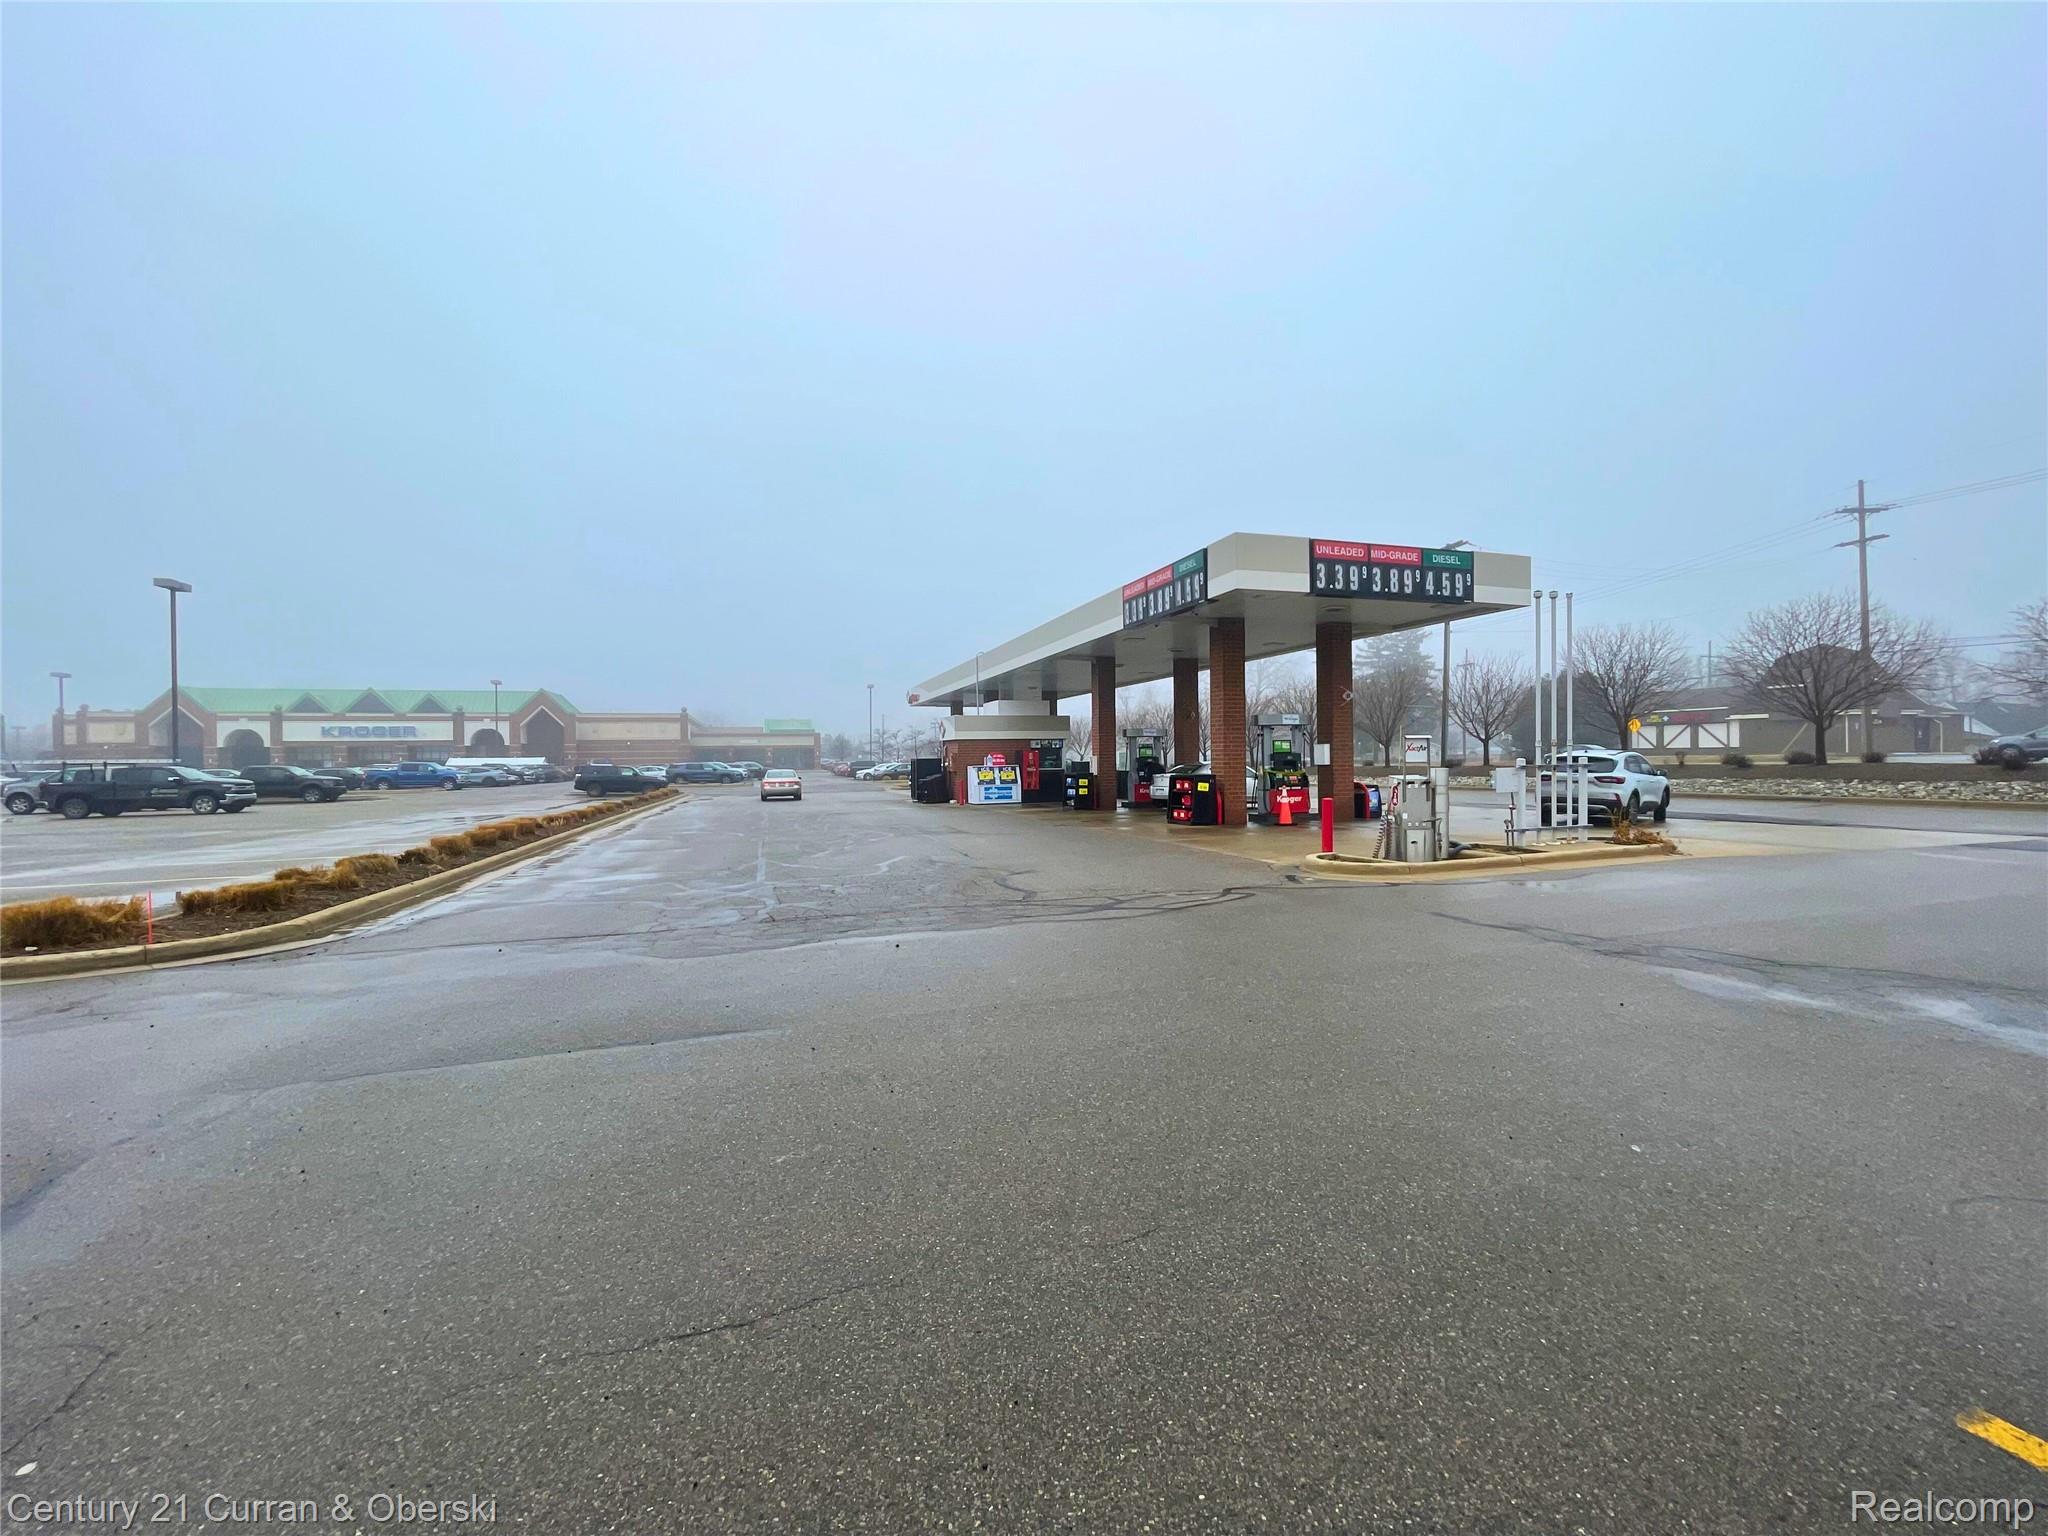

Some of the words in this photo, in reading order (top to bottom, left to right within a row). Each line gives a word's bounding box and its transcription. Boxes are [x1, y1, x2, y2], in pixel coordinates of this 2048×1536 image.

[1316, 545, 1364, 557] UNLEADED
[1371, 549, 1419, 561] MID-GRADE
[1432, 554, 1461, 565] DIESEL
[321, 726, 417, 738] KROGER
